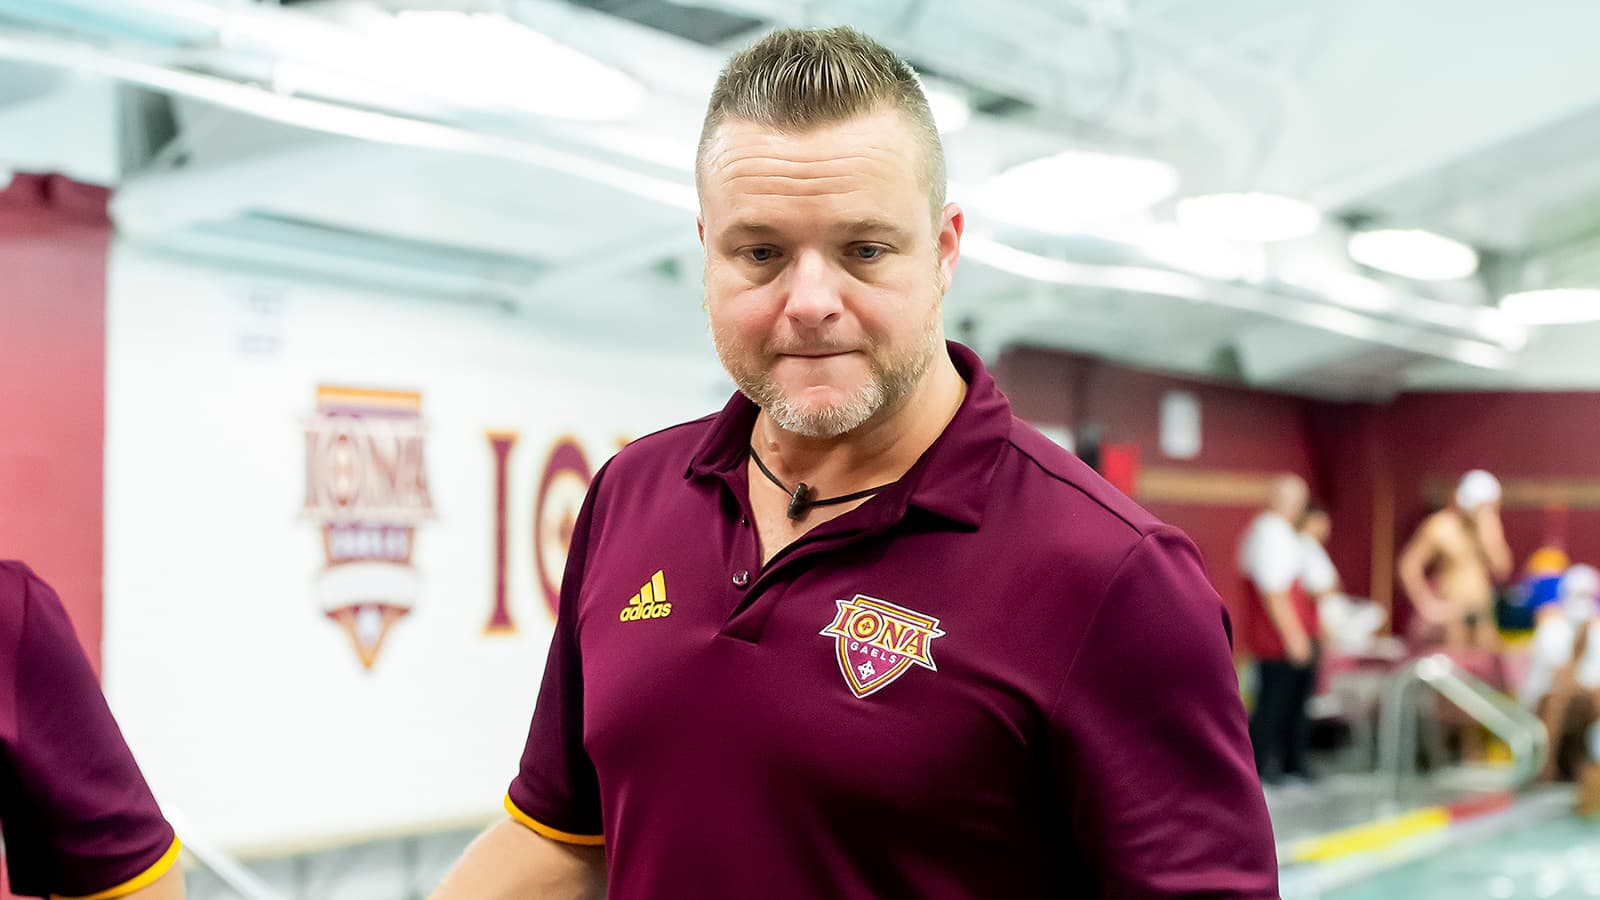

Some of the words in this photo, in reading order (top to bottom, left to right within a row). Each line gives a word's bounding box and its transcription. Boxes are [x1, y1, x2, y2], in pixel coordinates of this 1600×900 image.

[483, 430, 633, 636] IO
[619, 601, 672, 622] adidas
[831, 605, 930, 662] IONA
[849, 641, 897, 664] GAELS
